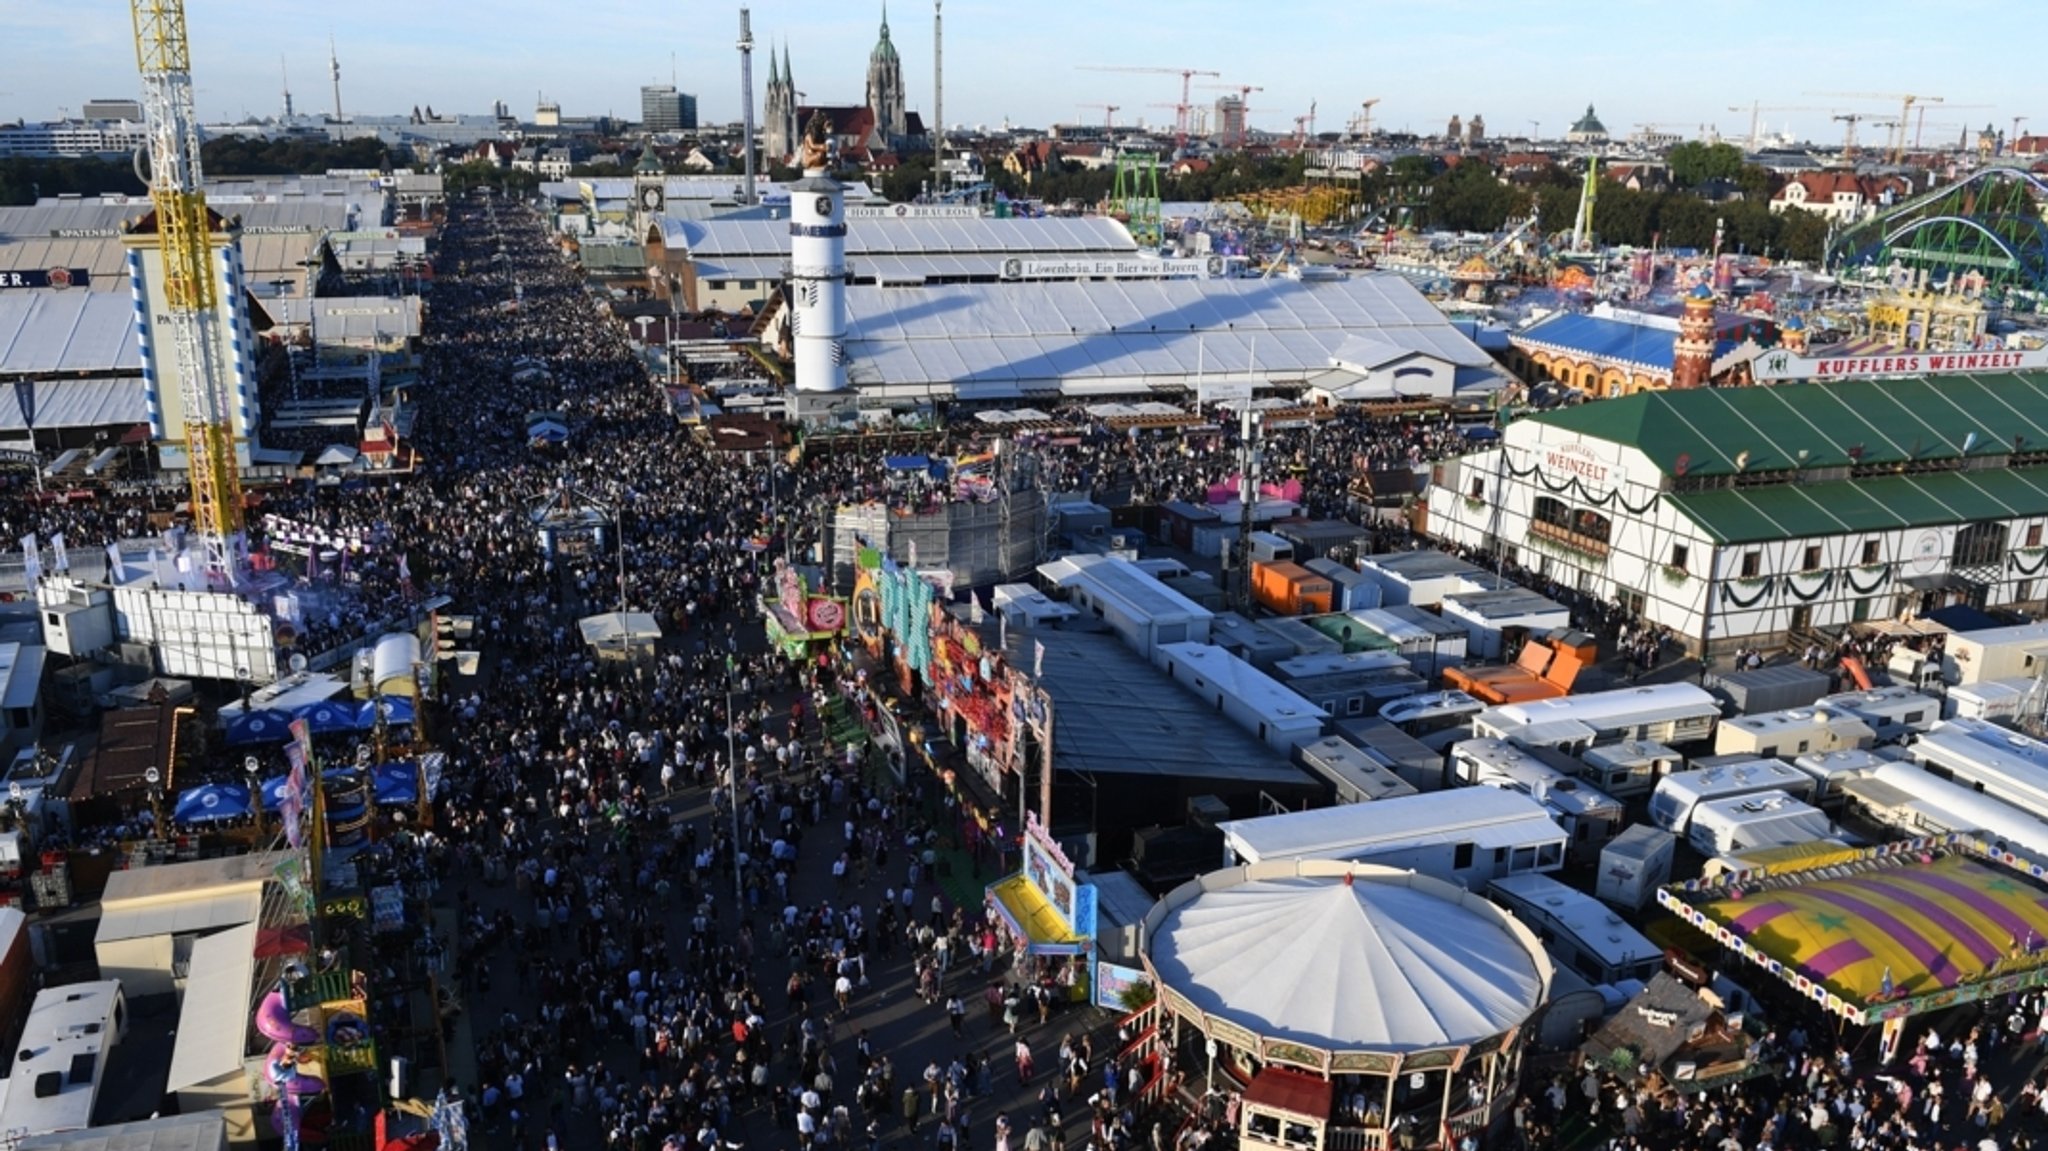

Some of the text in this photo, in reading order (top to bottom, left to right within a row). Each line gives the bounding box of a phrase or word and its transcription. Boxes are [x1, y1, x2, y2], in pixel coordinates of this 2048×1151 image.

[1095, 262, 1114, 273] Ein
[1117, 262, 1138, 273] Bier
[1141, 262, 1159, 273] wie
[1818, 353, 2023, 374] KUFFLERS WEINZELT
[1547, 451, 1608, 482] WEINZELT
